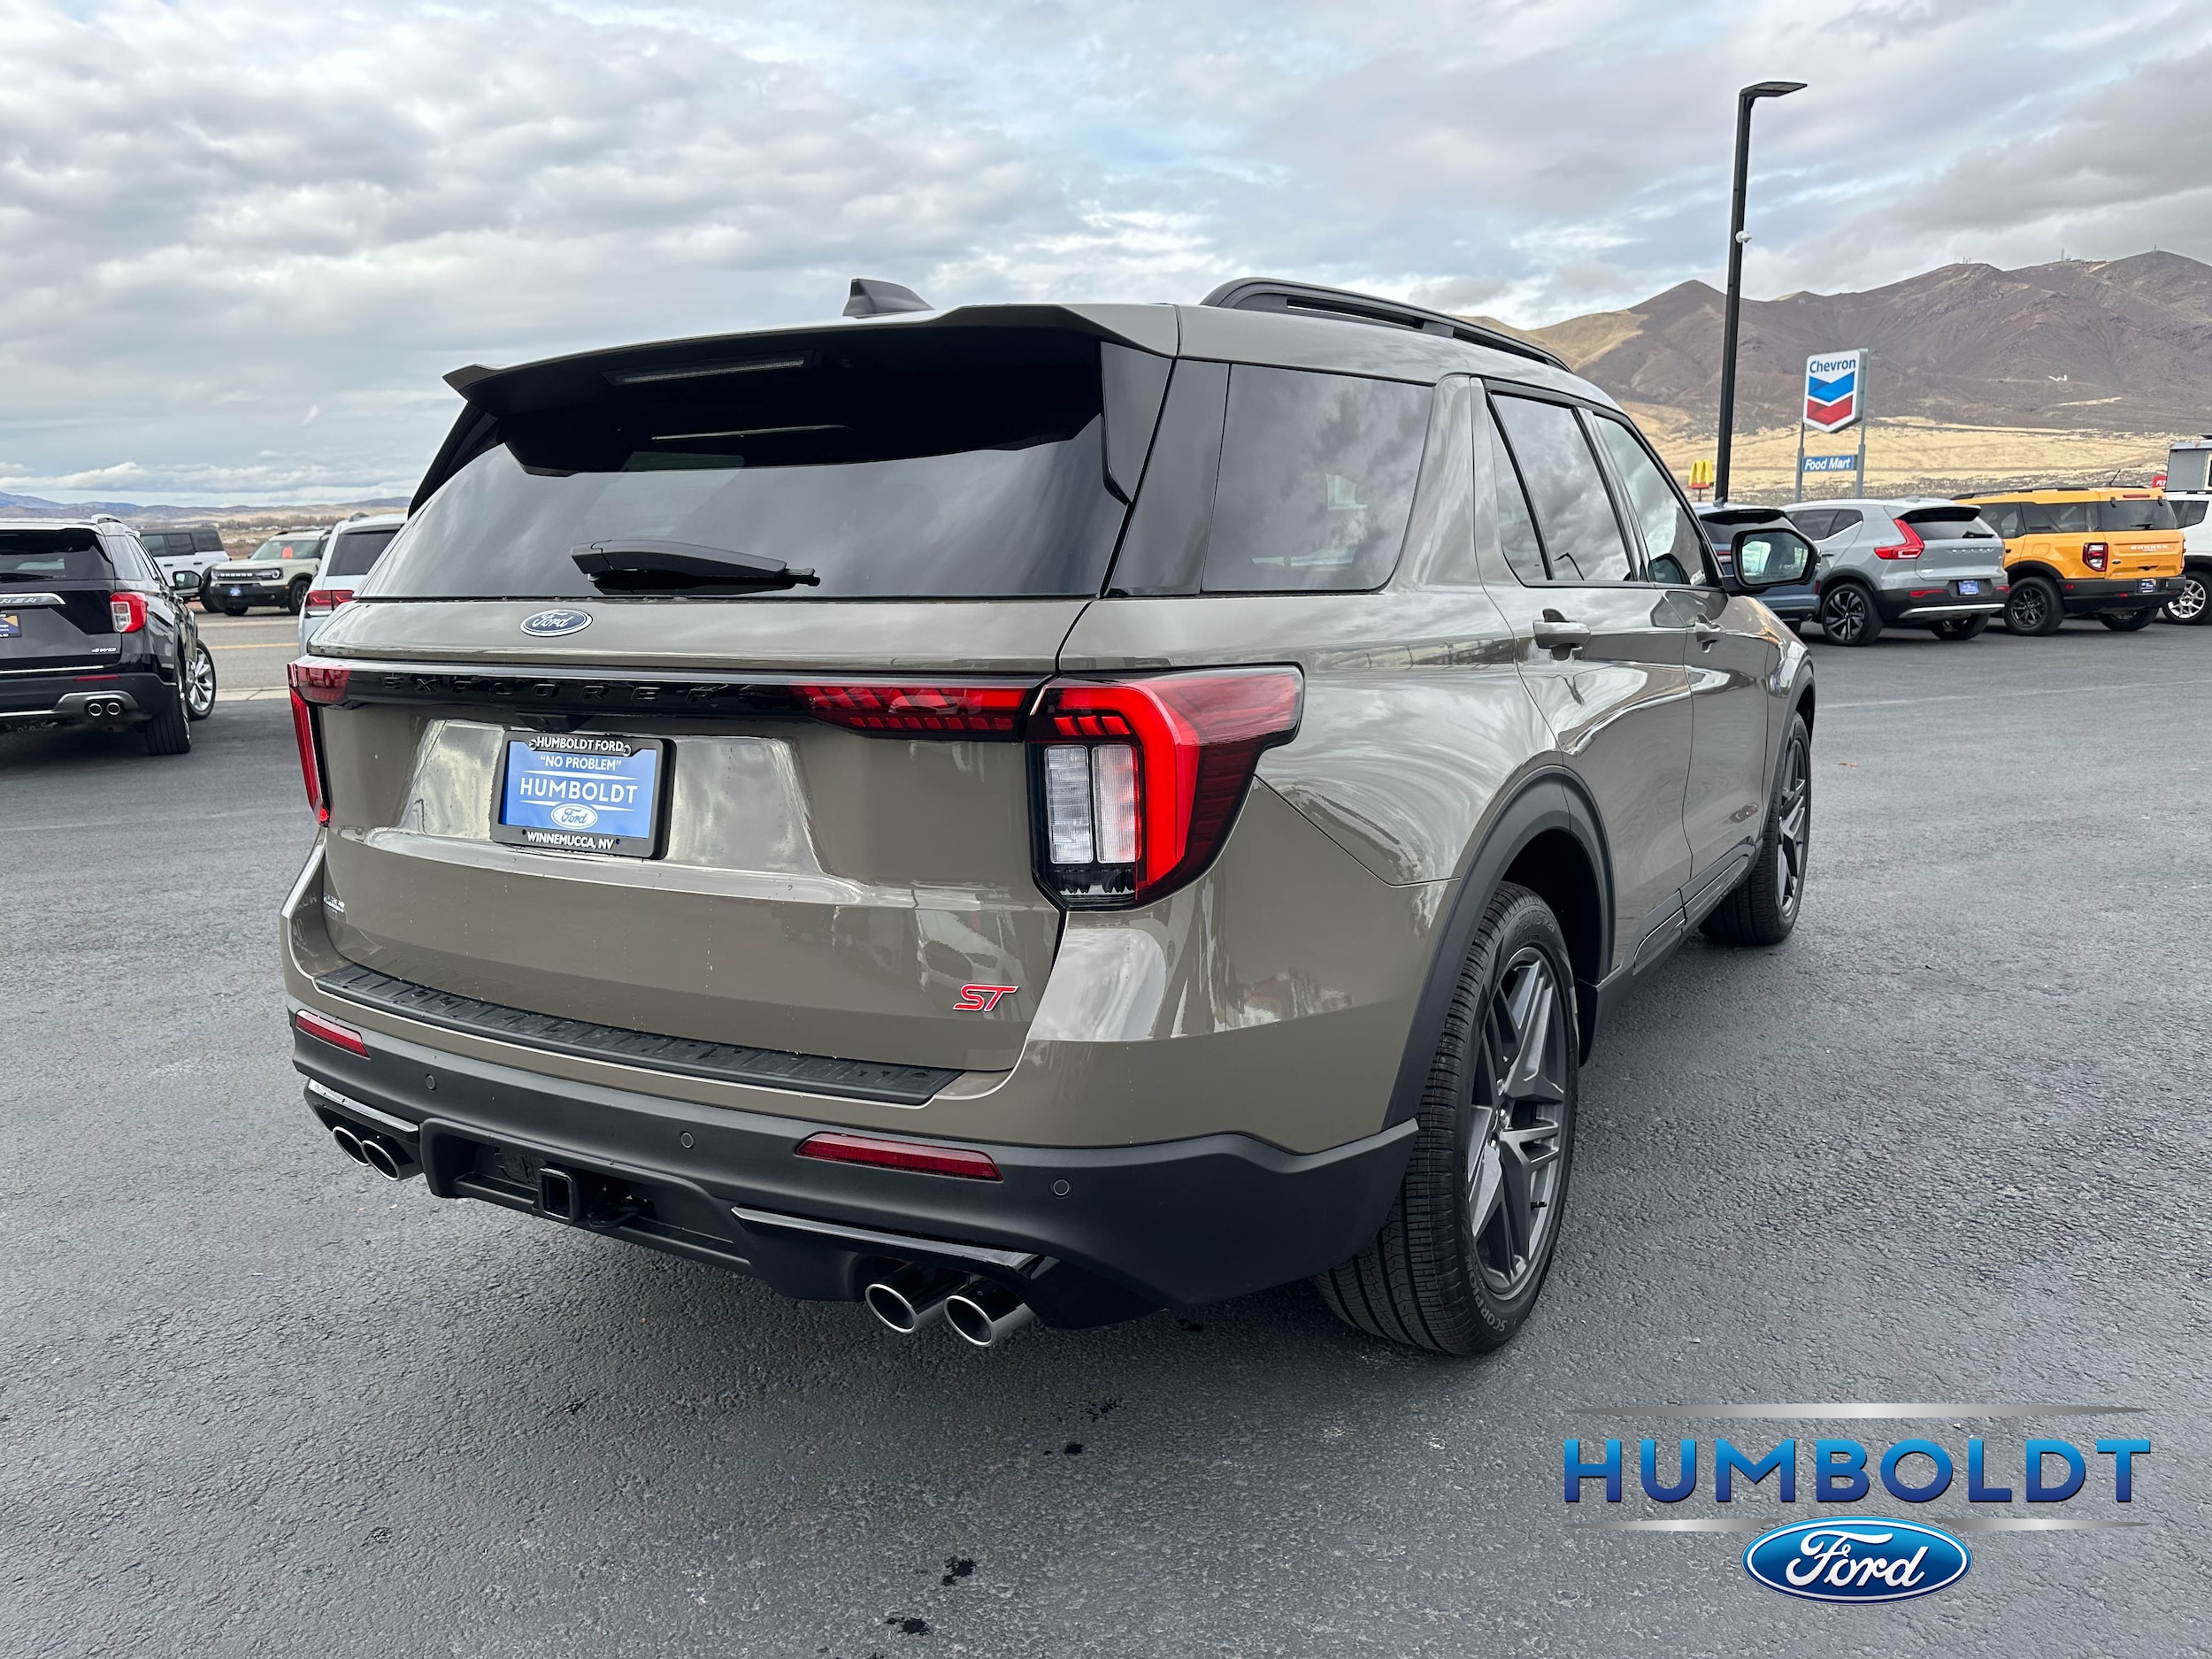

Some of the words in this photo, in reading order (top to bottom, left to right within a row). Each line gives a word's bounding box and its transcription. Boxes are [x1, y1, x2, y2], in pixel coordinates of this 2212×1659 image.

[1809, 358, 1856, 373] Chevron
[1805, 458, 1827, 470] Food
[1828, 457, 1851, 470] Mart
[532, 612, 574, 627] Ford
[382, 672, 718, 704] EXPLORER
[536, 735, 595, 751] HUMBOLDT
[595, 739, 624, 752] FORD
[519, 777, 638, 804] HUMBOLDT
[561, 807, 588, 825] Ford
[527, 831, 597, 849] WINNEMUCCA,
[598, 837, 614, 849] NV
[952, 983, 1019, 1012] ST
[1464, 1254, 1509, 1333] SCORPION
